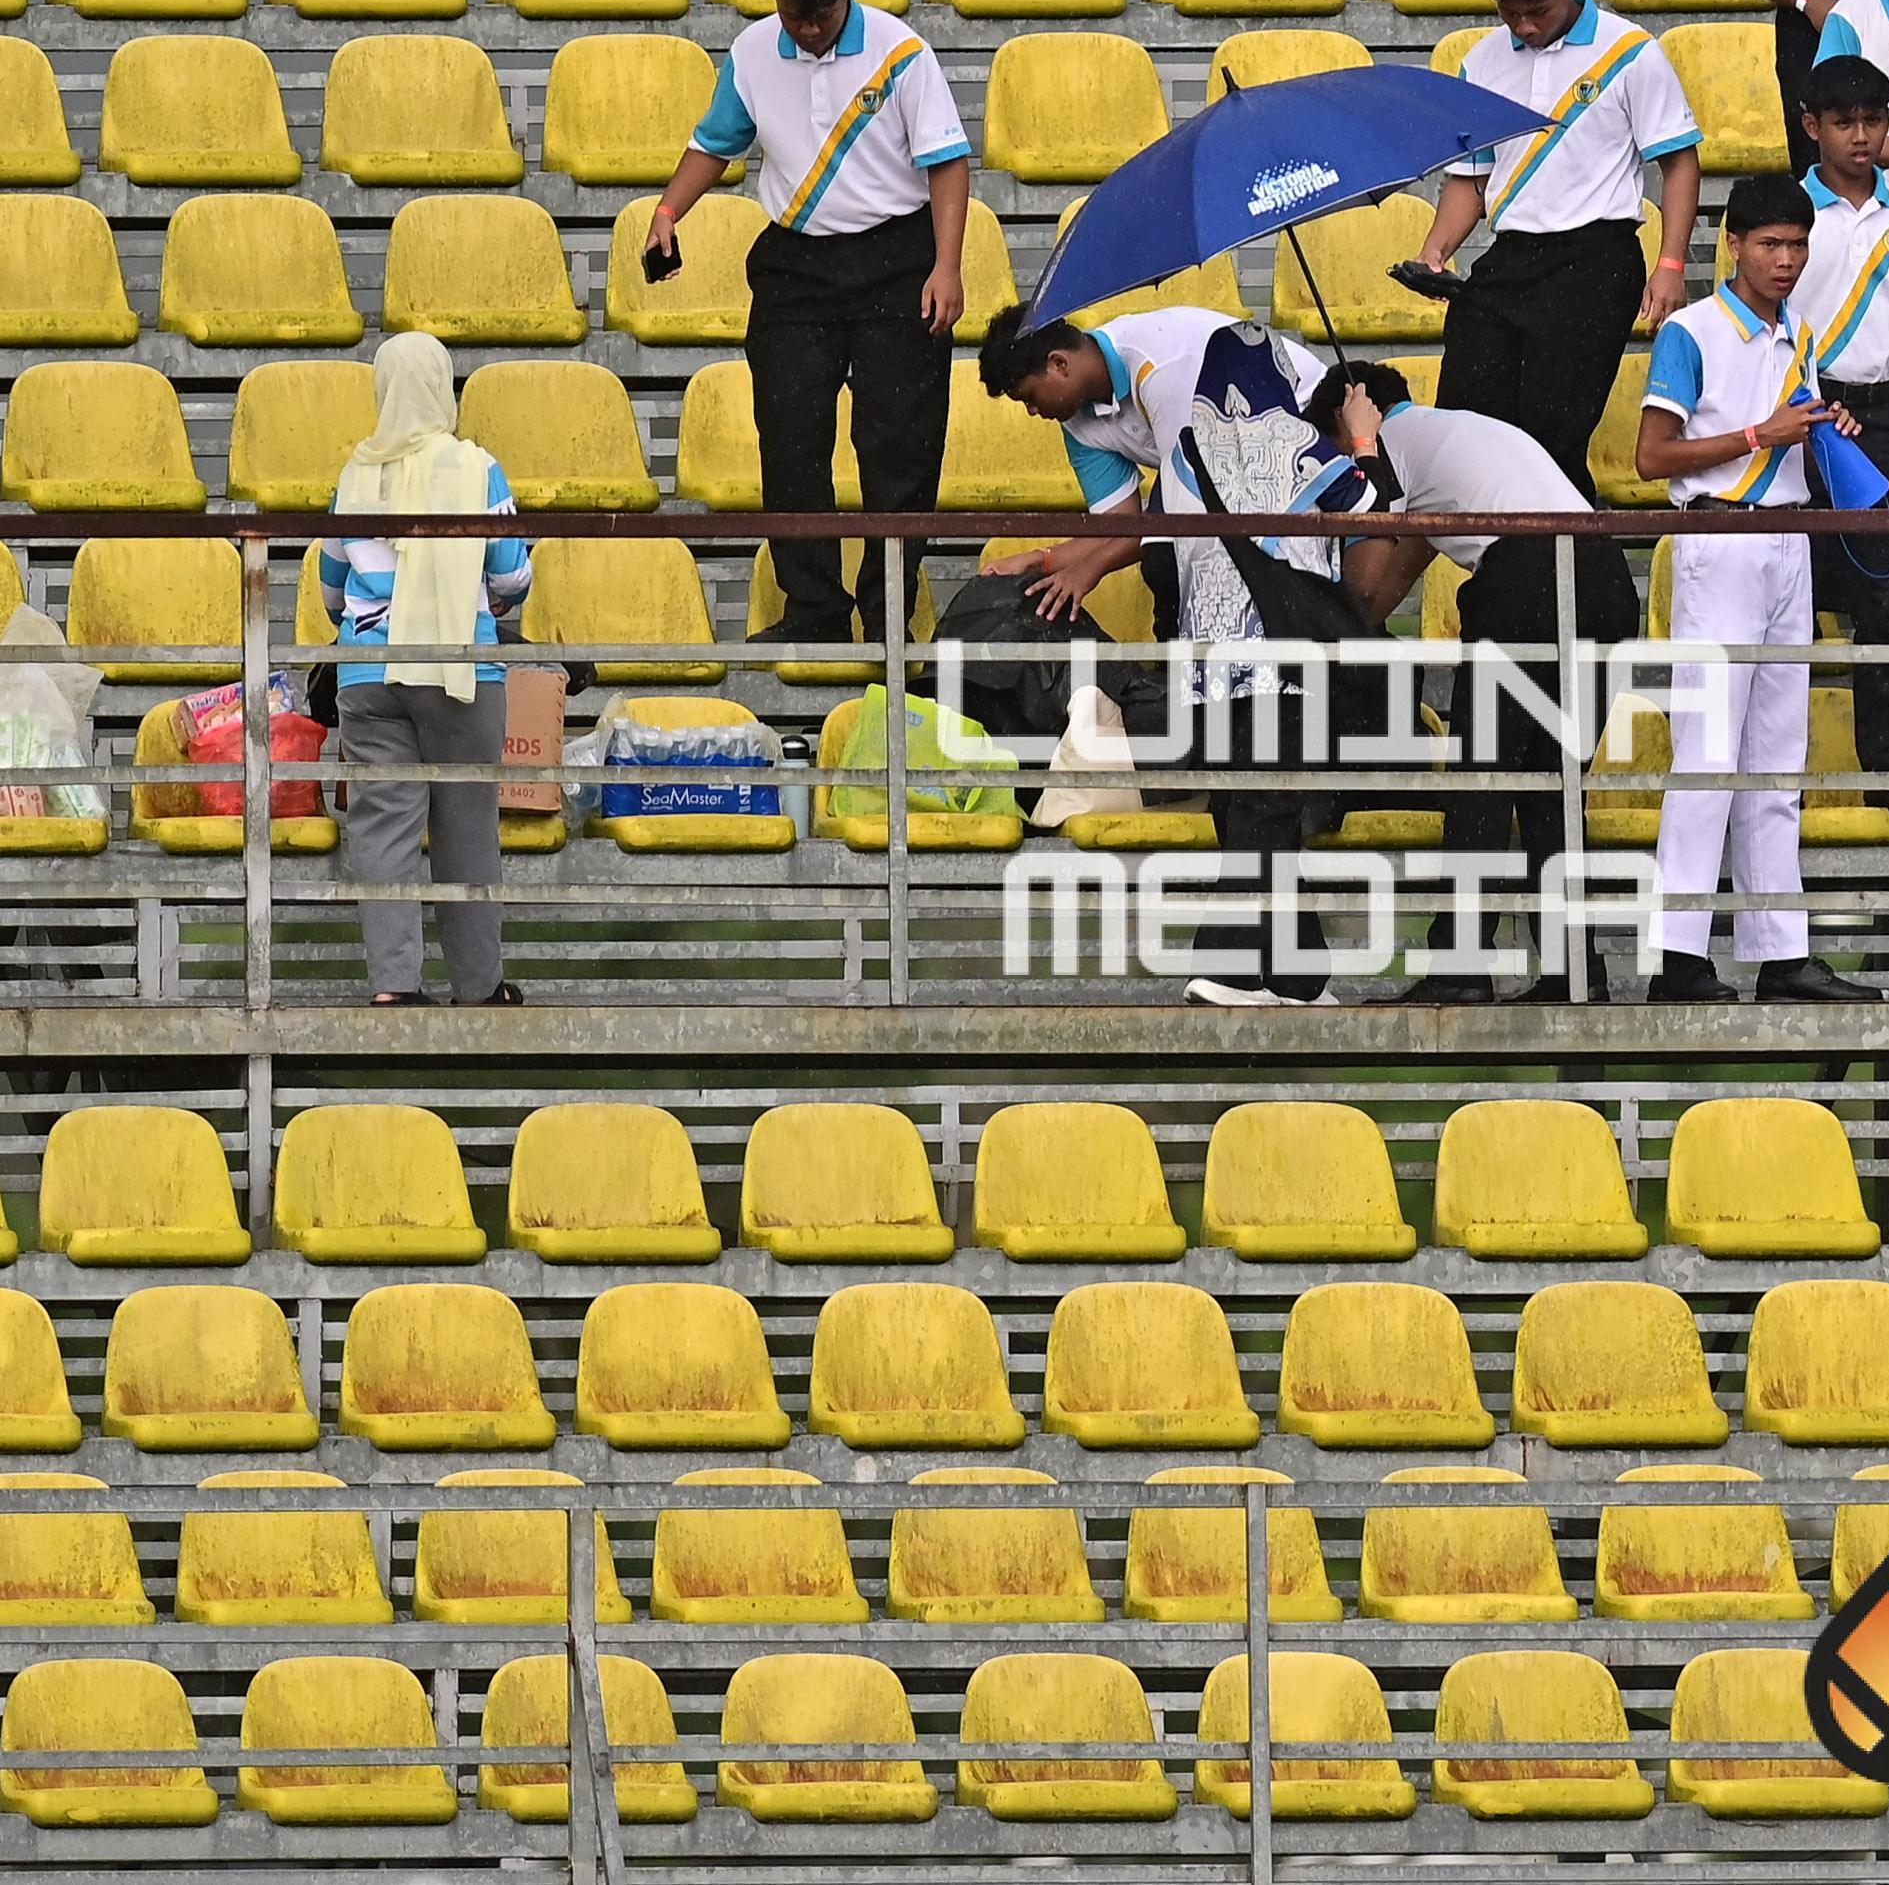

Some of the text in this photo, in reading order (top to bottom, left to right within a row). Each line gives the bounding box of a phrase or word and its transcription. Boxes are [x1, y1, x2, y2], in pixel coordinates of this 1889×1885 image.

[1247, 169, 1341, 216] INSTITUTION
[1253, 162, 1324, 199] VICTORIA
[510, 787, 535, 798] 8402
[641, 787, 723, 806] SeaMaster
